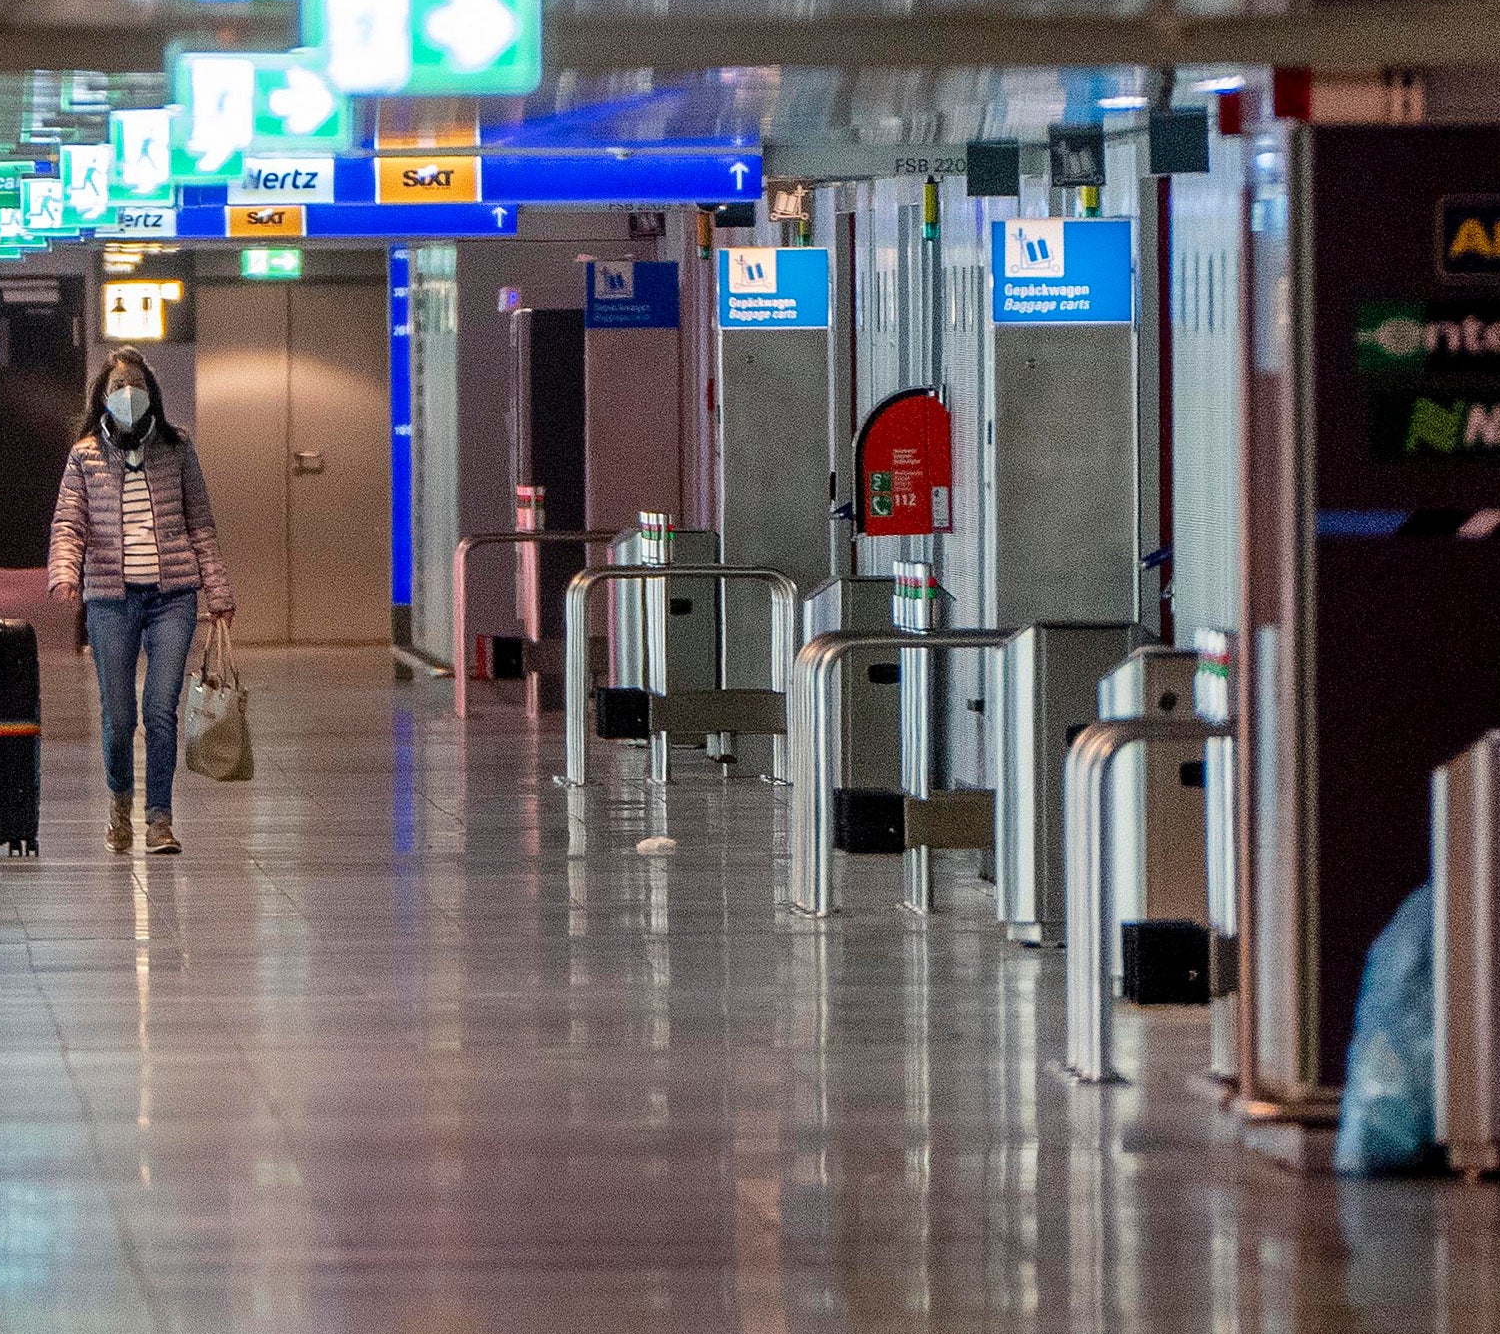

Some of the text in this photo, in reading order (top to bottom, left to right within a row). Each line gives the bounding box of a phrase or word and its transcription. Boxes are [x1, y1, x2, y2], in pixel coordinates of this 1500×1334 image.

[895, 158, 928, 173] FSB
[121, 212, 163, 228] ertz
[1004, 284, 1090, 298] Gepäckwagen
[1003, 298, 1090, 313] Baggage carts
[894, 493, 917, 507] 112
